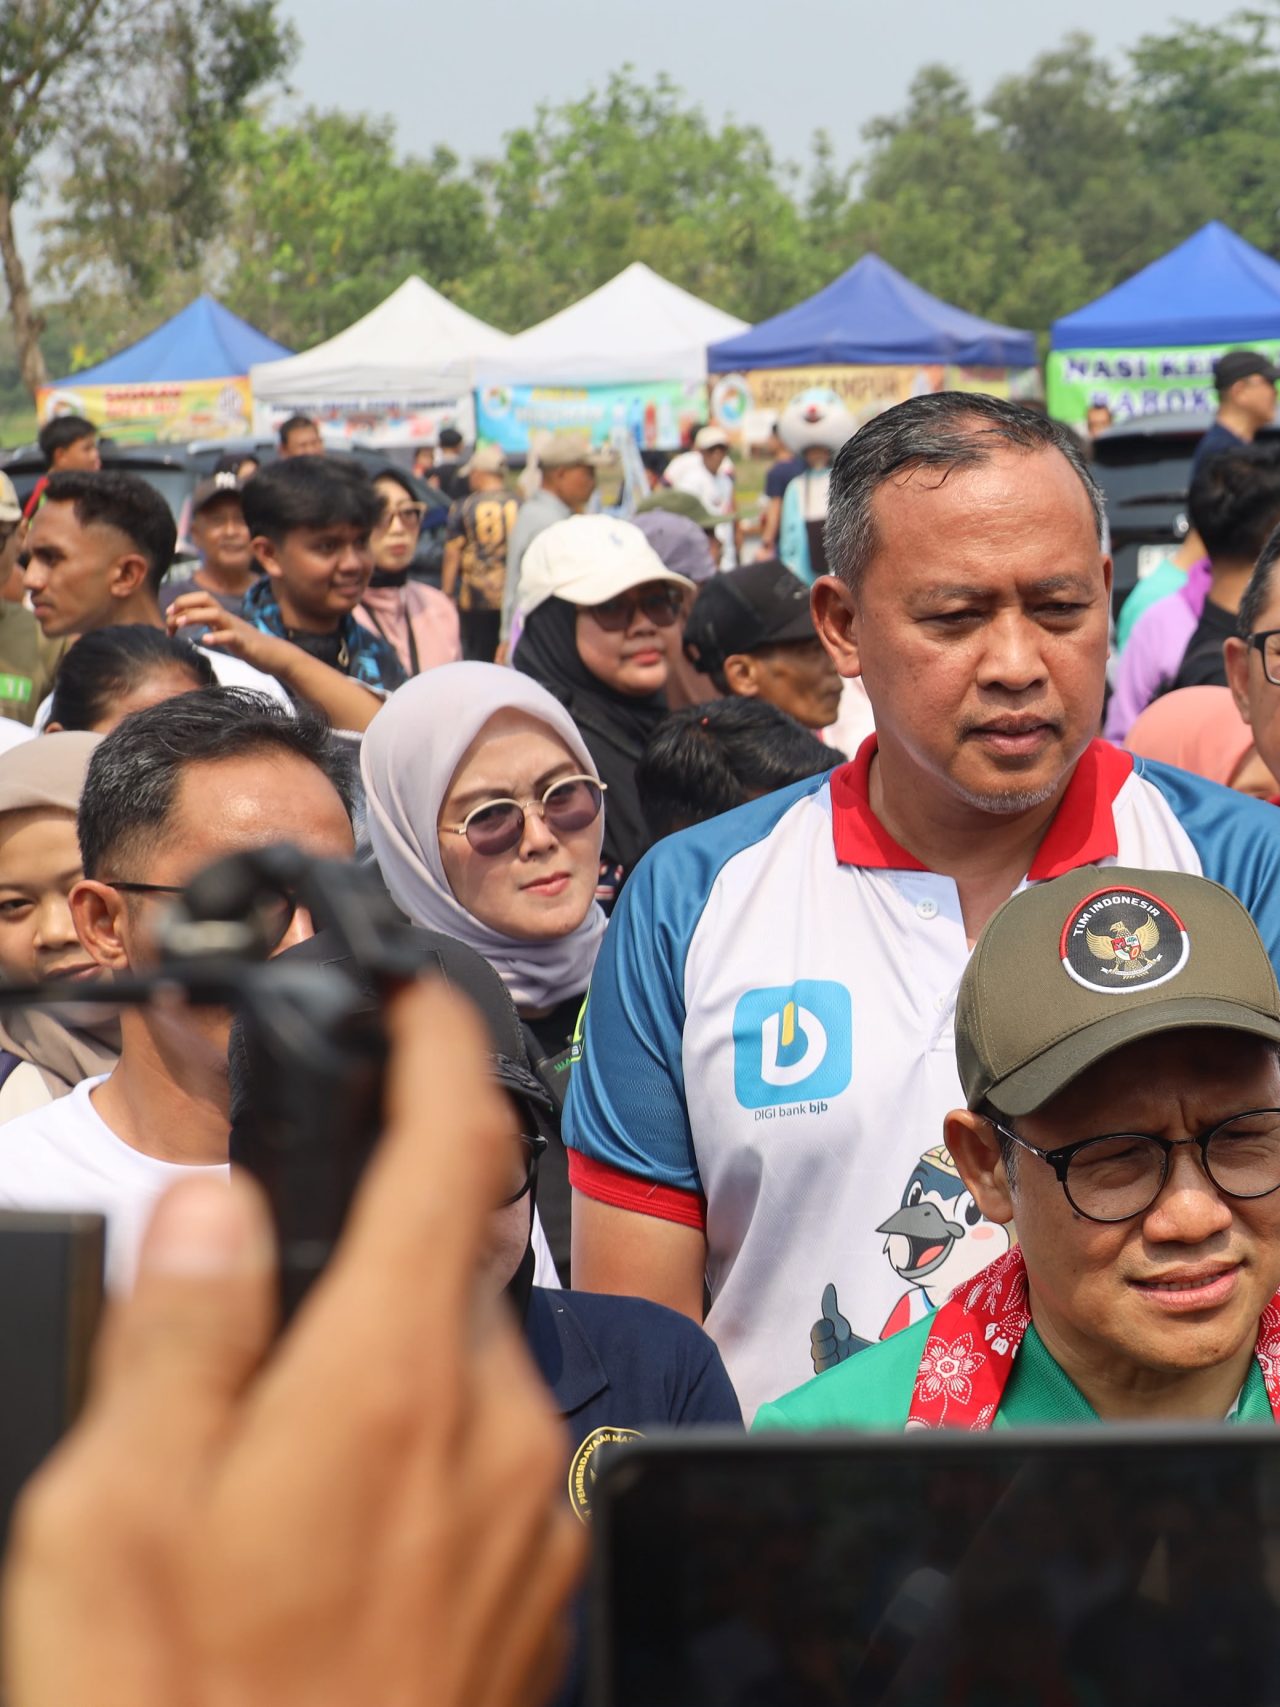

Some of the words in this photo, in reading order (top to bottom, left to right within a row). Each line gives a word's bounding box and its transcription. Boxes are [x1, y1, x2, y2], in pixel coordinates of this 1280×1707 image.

[1066, 356, 1147, 379] NASI
[1073, 912, 1092, 937] TIM
[1089, 895, 1160, 917] INDONESIA
[754, 1103, 776, 1122] DIGI
[779, 1101, 807, 1118] bank
[808, 1095, 829, 1116] bjb
